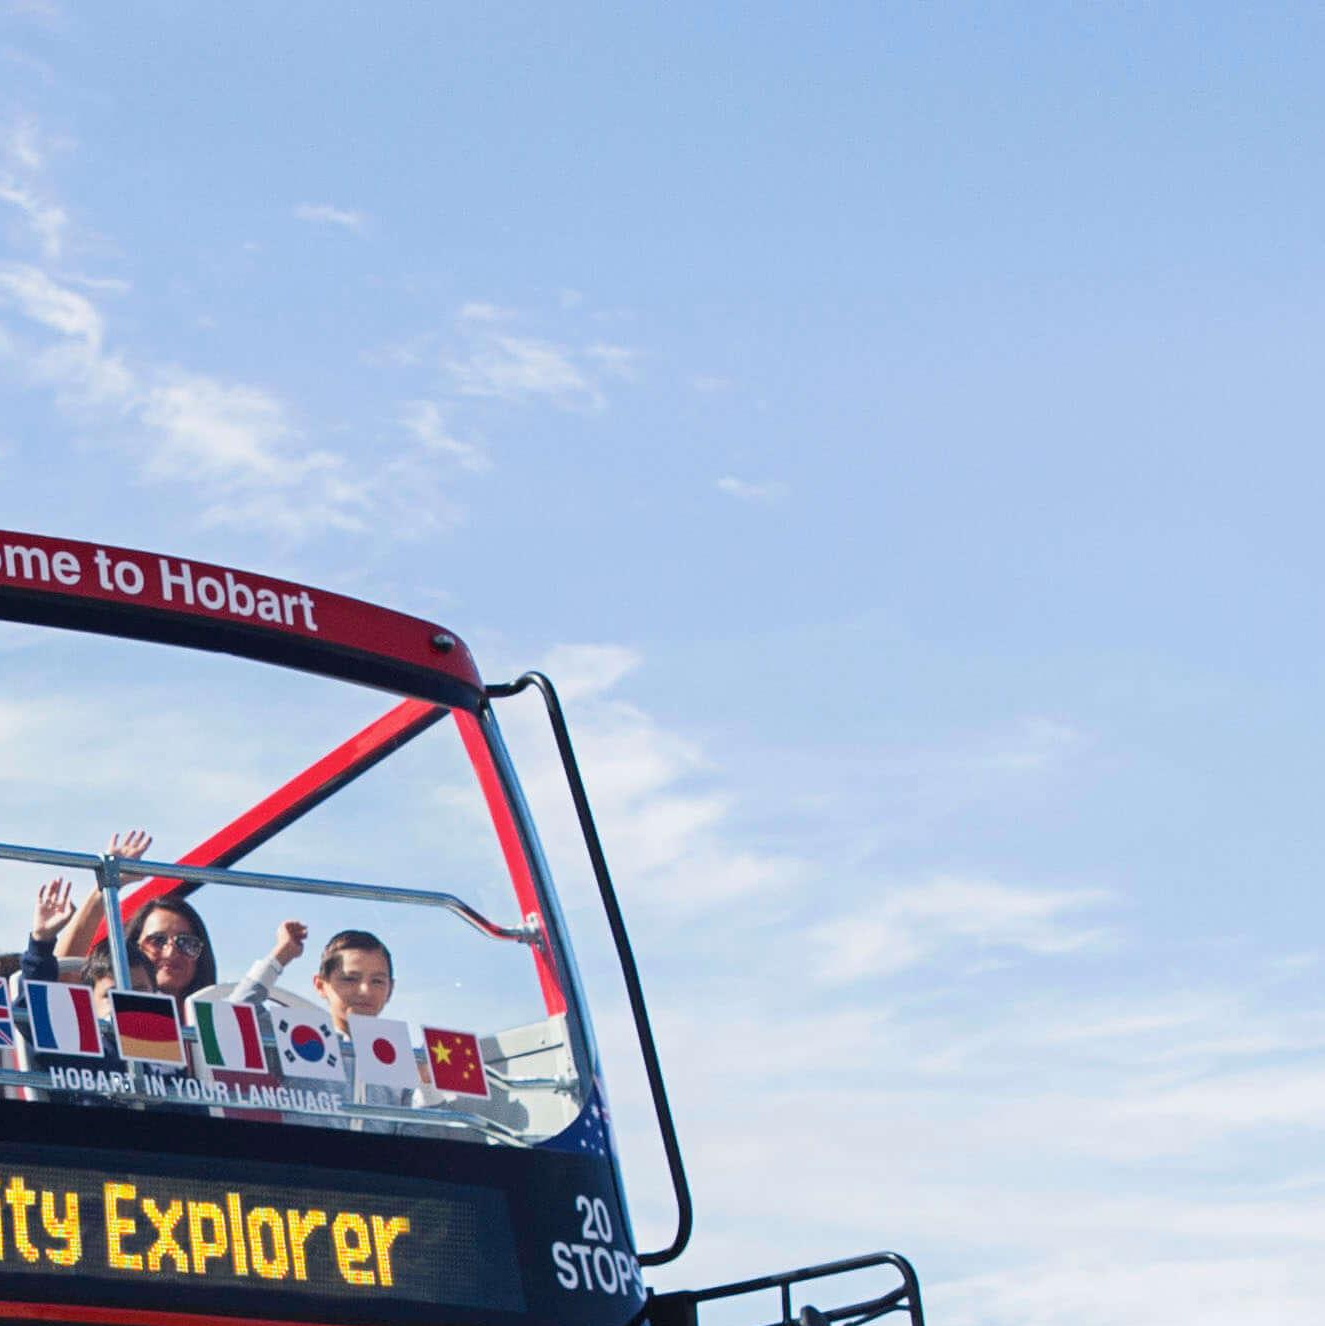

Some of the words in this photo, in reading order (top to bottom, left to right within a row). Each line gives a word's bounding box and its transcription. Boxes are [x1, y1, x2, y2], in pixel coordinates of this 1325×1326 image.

[94, 549, 145, 595] to
[158, 559, 318, 631] Hobart
[50, 1066, 136, 1095] HOBART
[144, 1073, 167, 1097] IN
[169, 1077, 229, 1103] YOUR
[236, 1084, 343, 1114] LANGUAGE
[104, 1182, 411, 1287] Explorer
[575, 1194, 613, 1243] 20
[552, 1241, 648, 1302] STOPS
